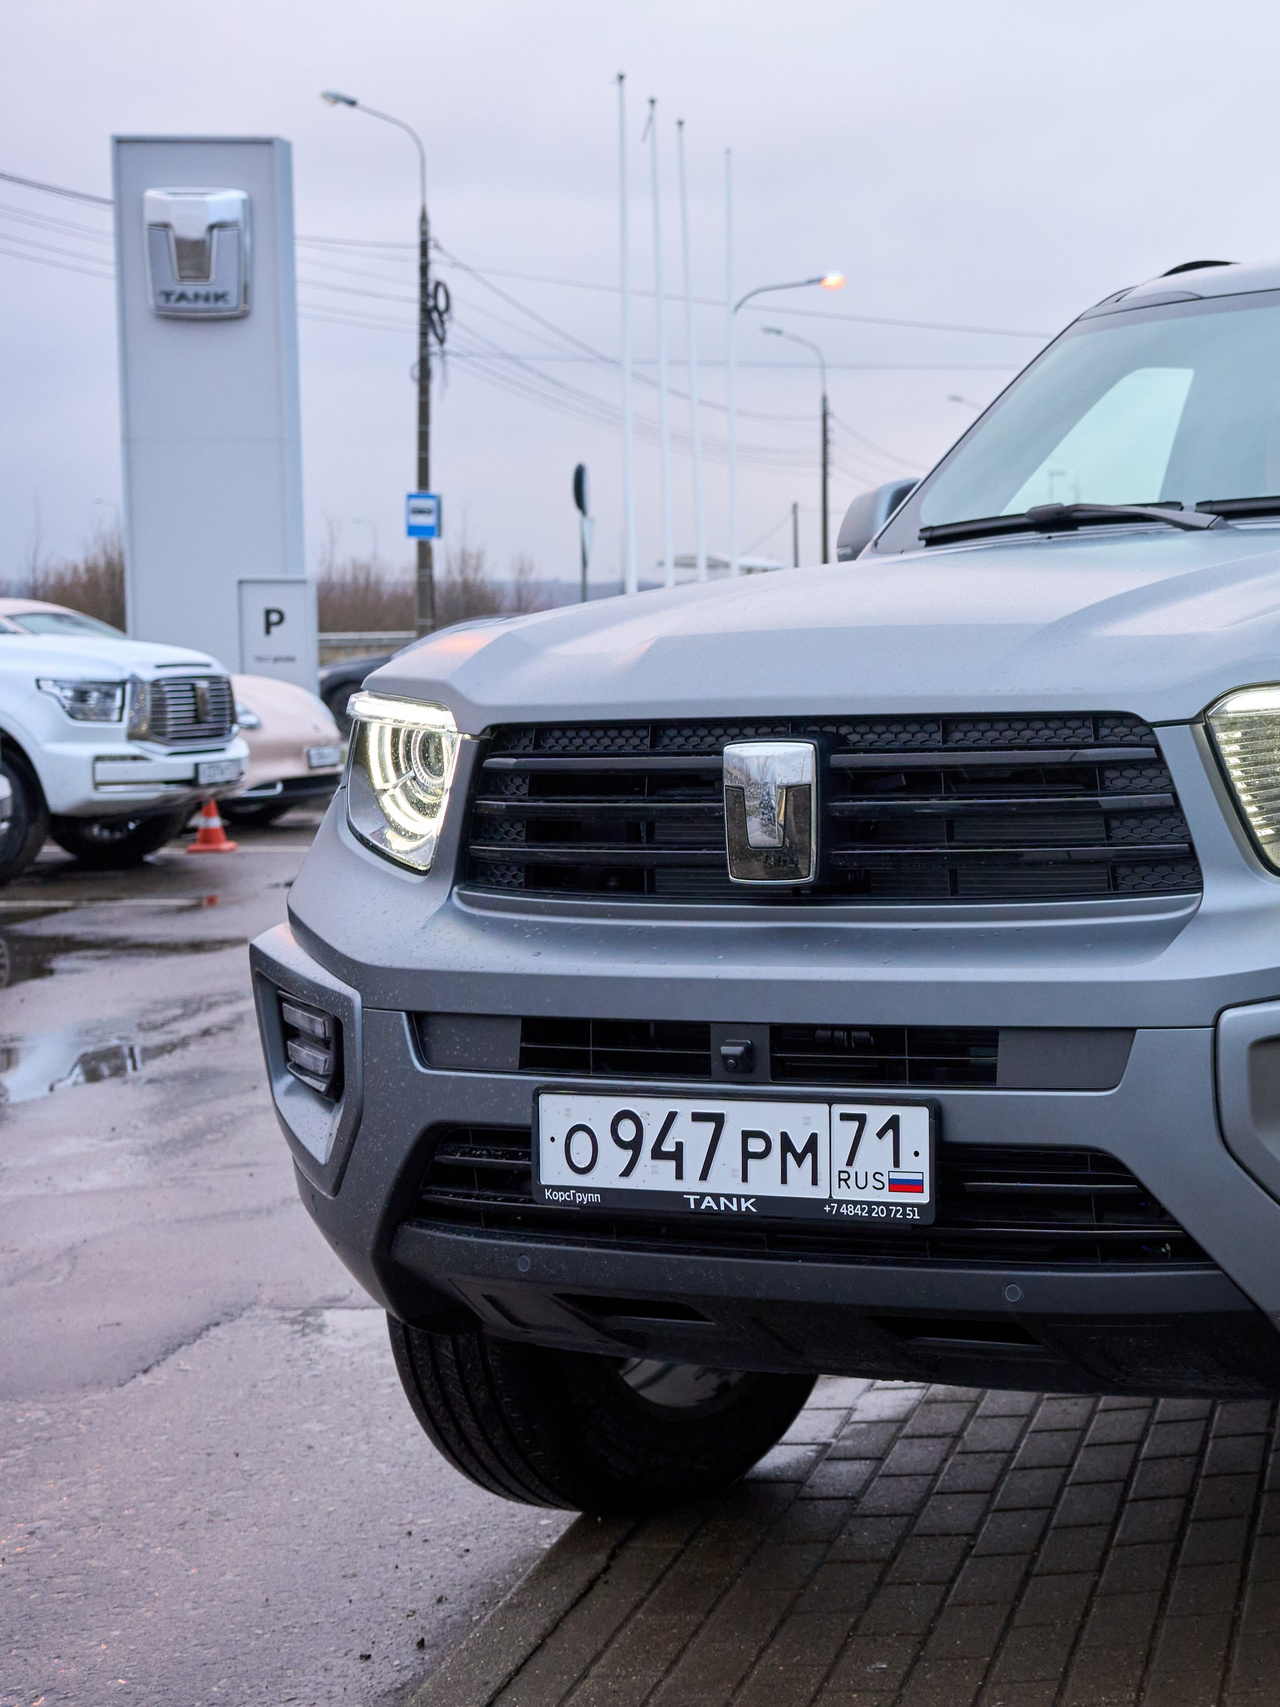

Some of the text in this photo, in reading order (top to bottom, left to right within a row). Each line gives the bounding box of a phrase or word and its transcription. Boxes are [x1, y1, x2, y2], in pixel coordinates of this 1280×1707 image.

[161, 290, 229, 304] TANK
[264, 608, 285, 636] P
[839, 1112, 901, 1168] 71
[838, 1170, 885, 1190] RUS
[544, 1188, 601, 1204] КорсГрупп
[683, 1194, 757, 1213] TANK
[823, 1203, 920, 1219] +7 4842 20 72 51
